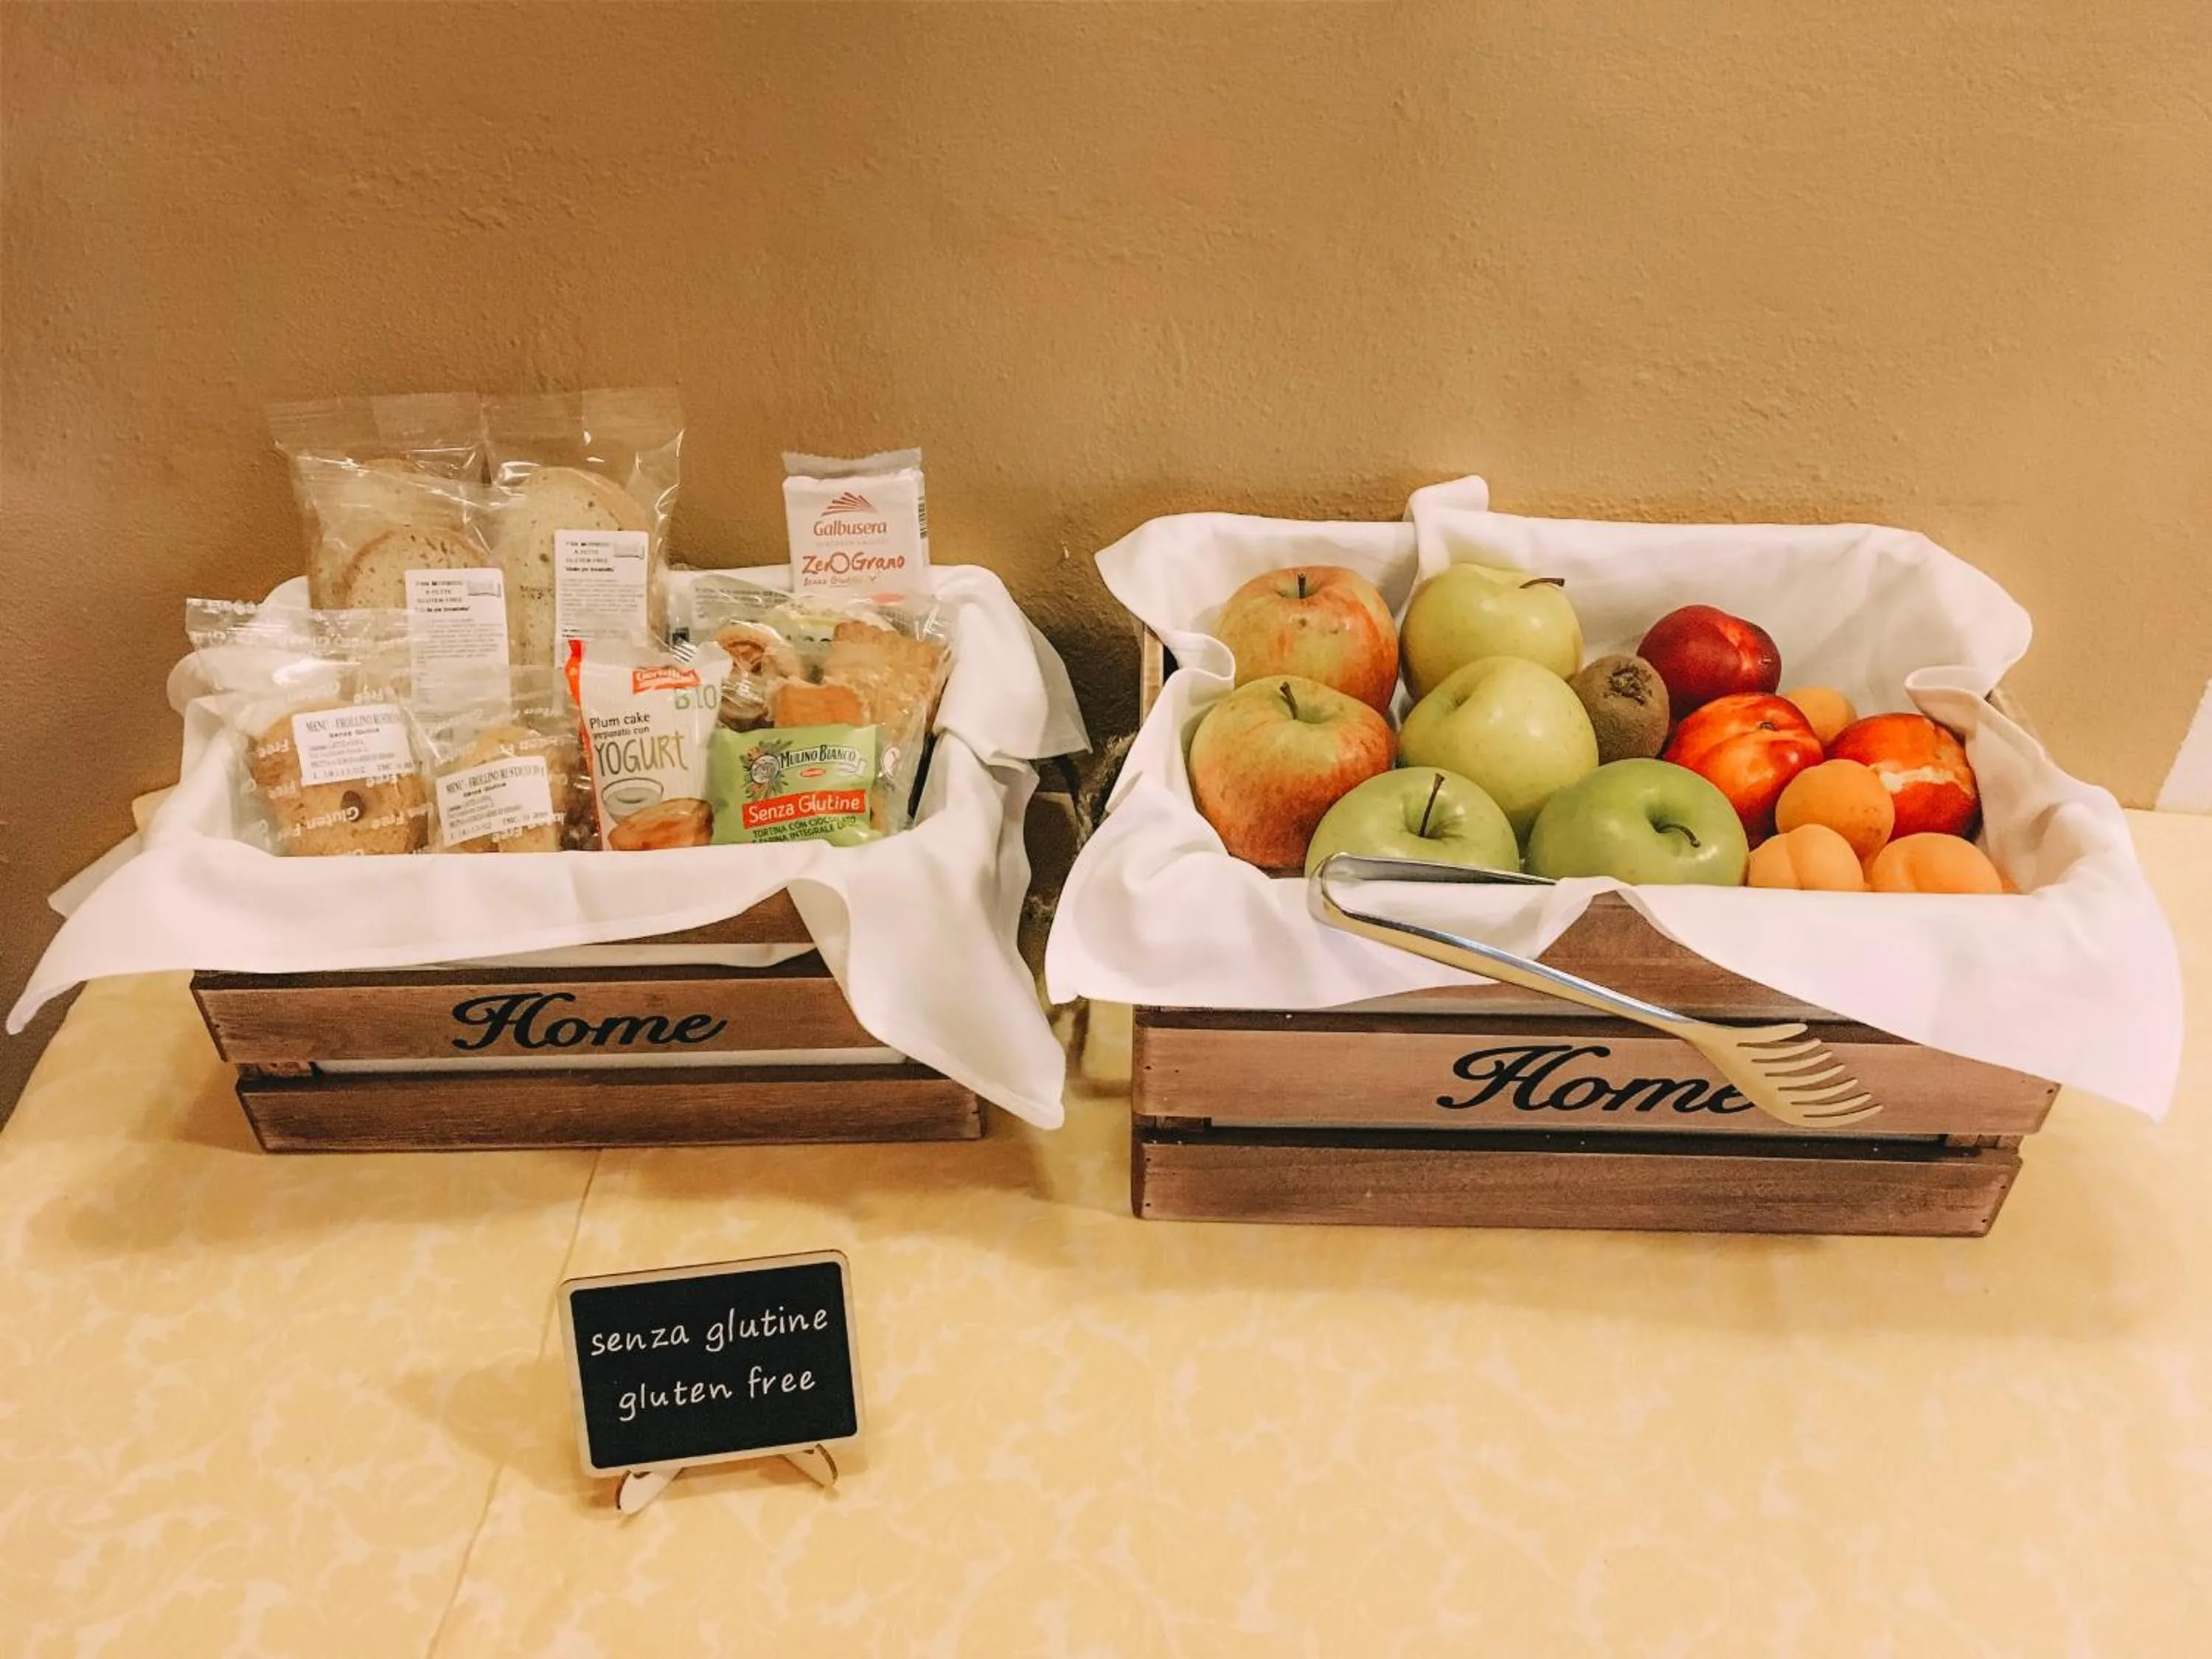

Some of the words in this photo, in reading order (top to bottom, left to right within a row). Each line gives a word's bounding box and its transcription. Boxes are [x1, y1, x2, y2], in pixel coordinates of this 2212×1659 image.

[813, 520, 888, 537] Galbusera
[674, 684, 717, 710] BIO
[590, 716, 620, 729] Plum
[623, 712, 650, 726] cake
[779, 751, 818, 768] MULINO
[819, 744, 856, 762] BIANCO
[748, 802, 796, 824] Senza
[799, 793, 861, 813] Glutine
[753, 825, 787, 838] TORTINA
[451, 992, 728, 1051] Home
[1436, 1045, 1757, 1113] Home
[590, 1324, 690, 1356] senza
[705, 1305, 829, 1352] glutine
[618, 1380, 733, 1422] gluten
[747, 1366, 815, 1399] free
